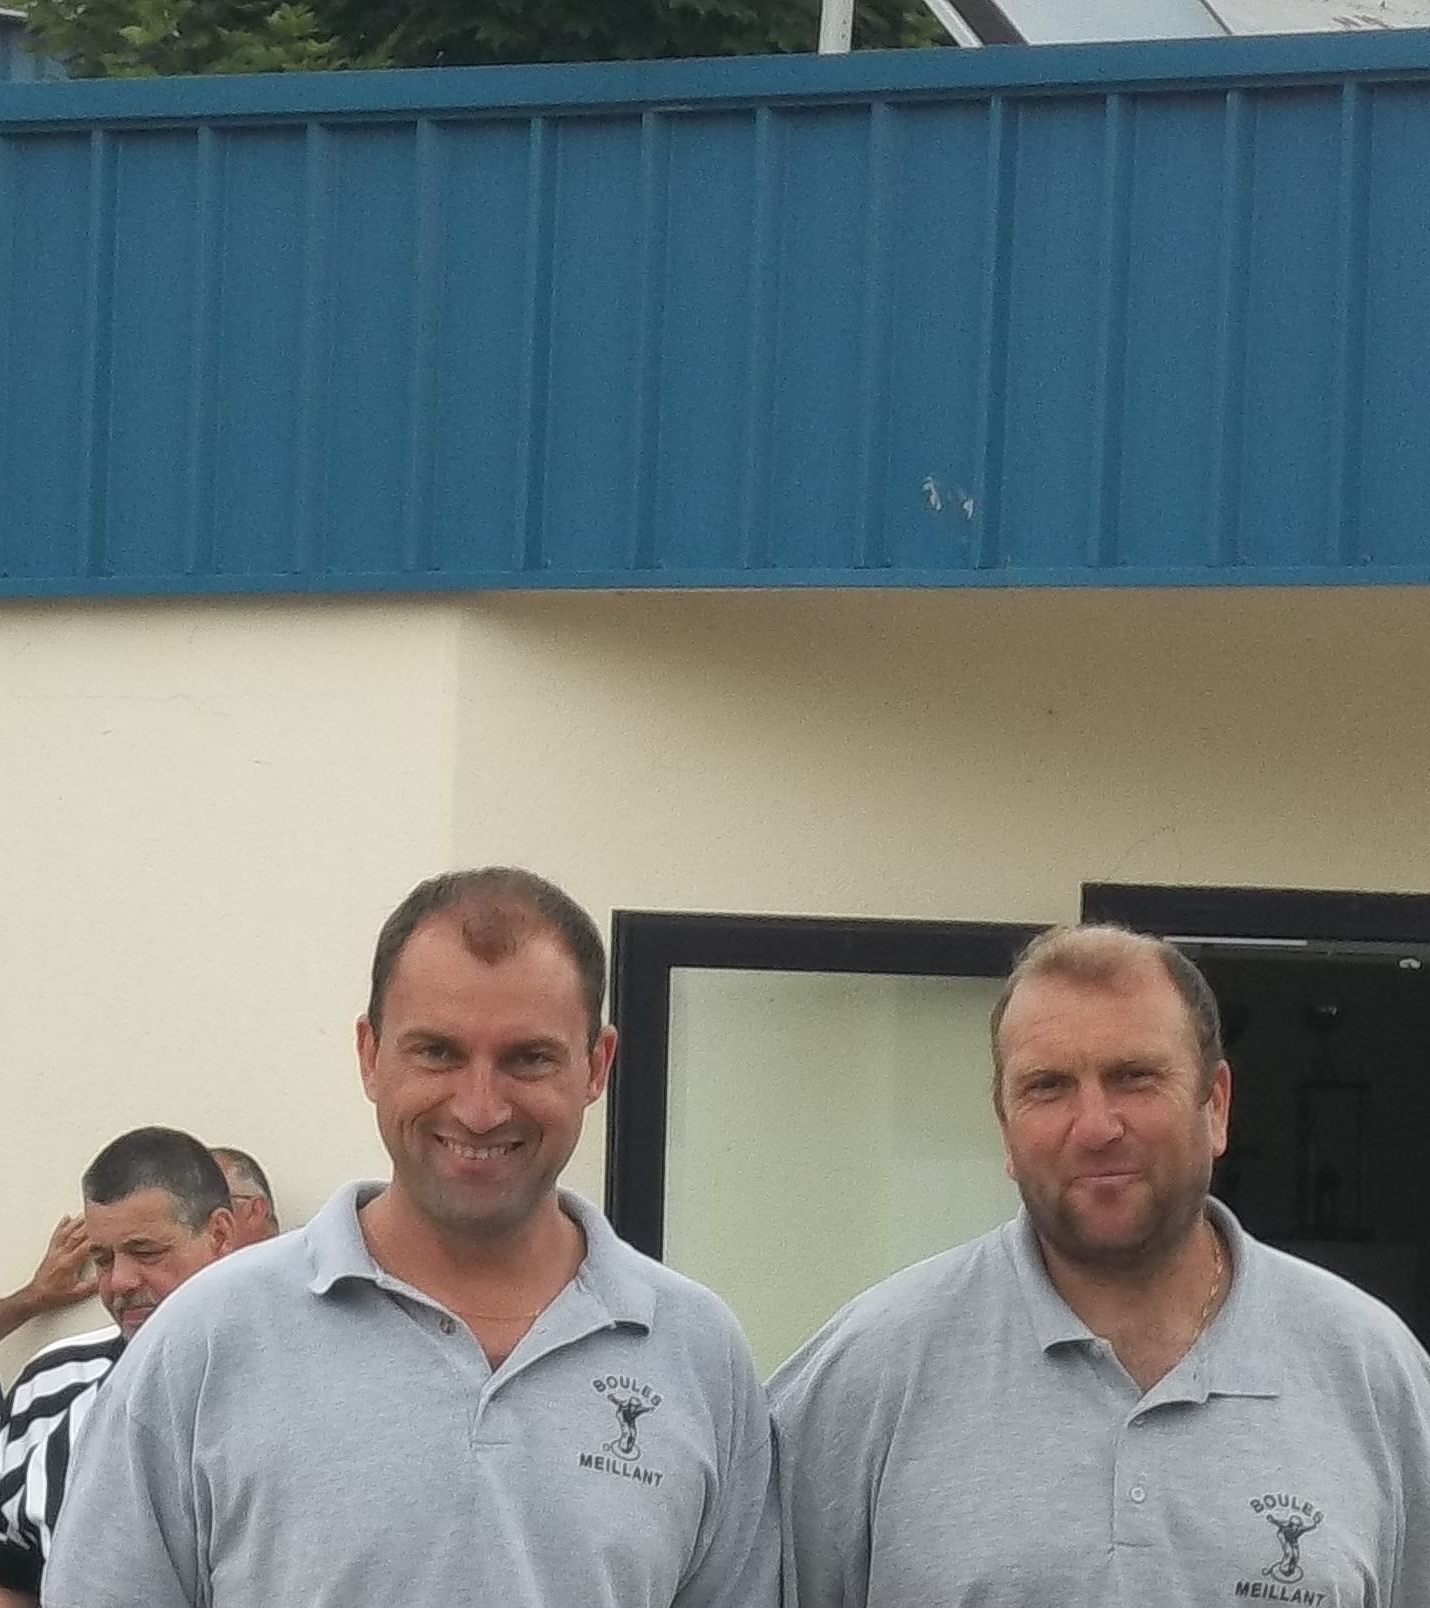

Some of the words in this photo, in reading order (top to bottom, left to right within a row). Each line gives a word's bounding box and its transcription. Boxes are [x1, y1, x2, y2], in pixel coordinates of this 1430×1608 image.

[592, 1375, 663, 1407] BOULES
[578, 1452, 664, 1488] MEILLANT
[1249, 1493, 1325, 1525] BOULES
[1234, 1580, 1328, 1607] MEILLANT
